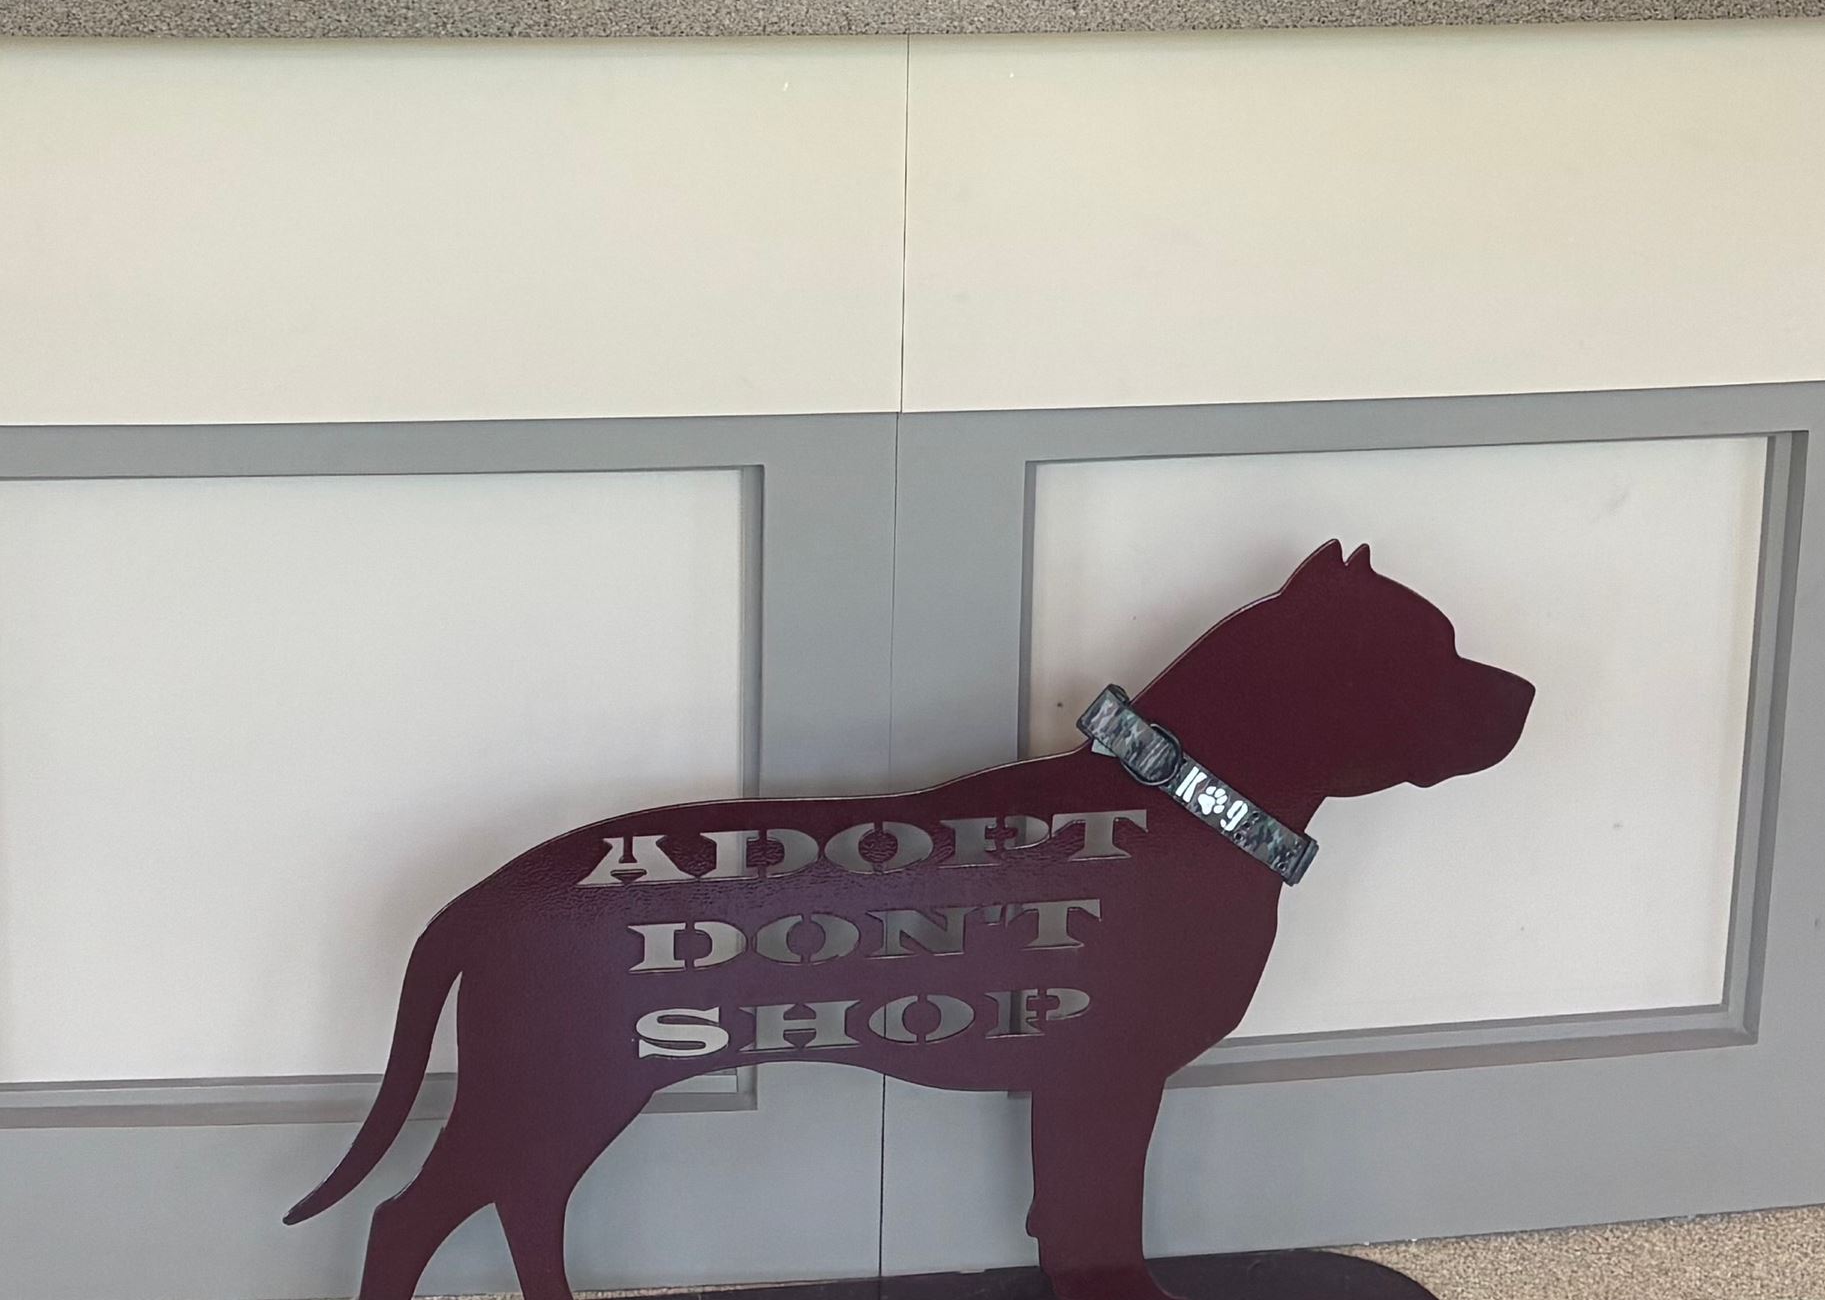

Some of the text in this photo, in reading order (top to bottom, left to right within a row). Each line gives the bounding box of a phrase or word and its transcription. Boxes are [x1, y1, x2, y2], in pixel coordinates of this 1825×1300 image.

[577, 809, 1149, 887] ADOPT
[628, 898, 1102, 974] DON'T
[634, 986, 1092, 1060] SHOP
